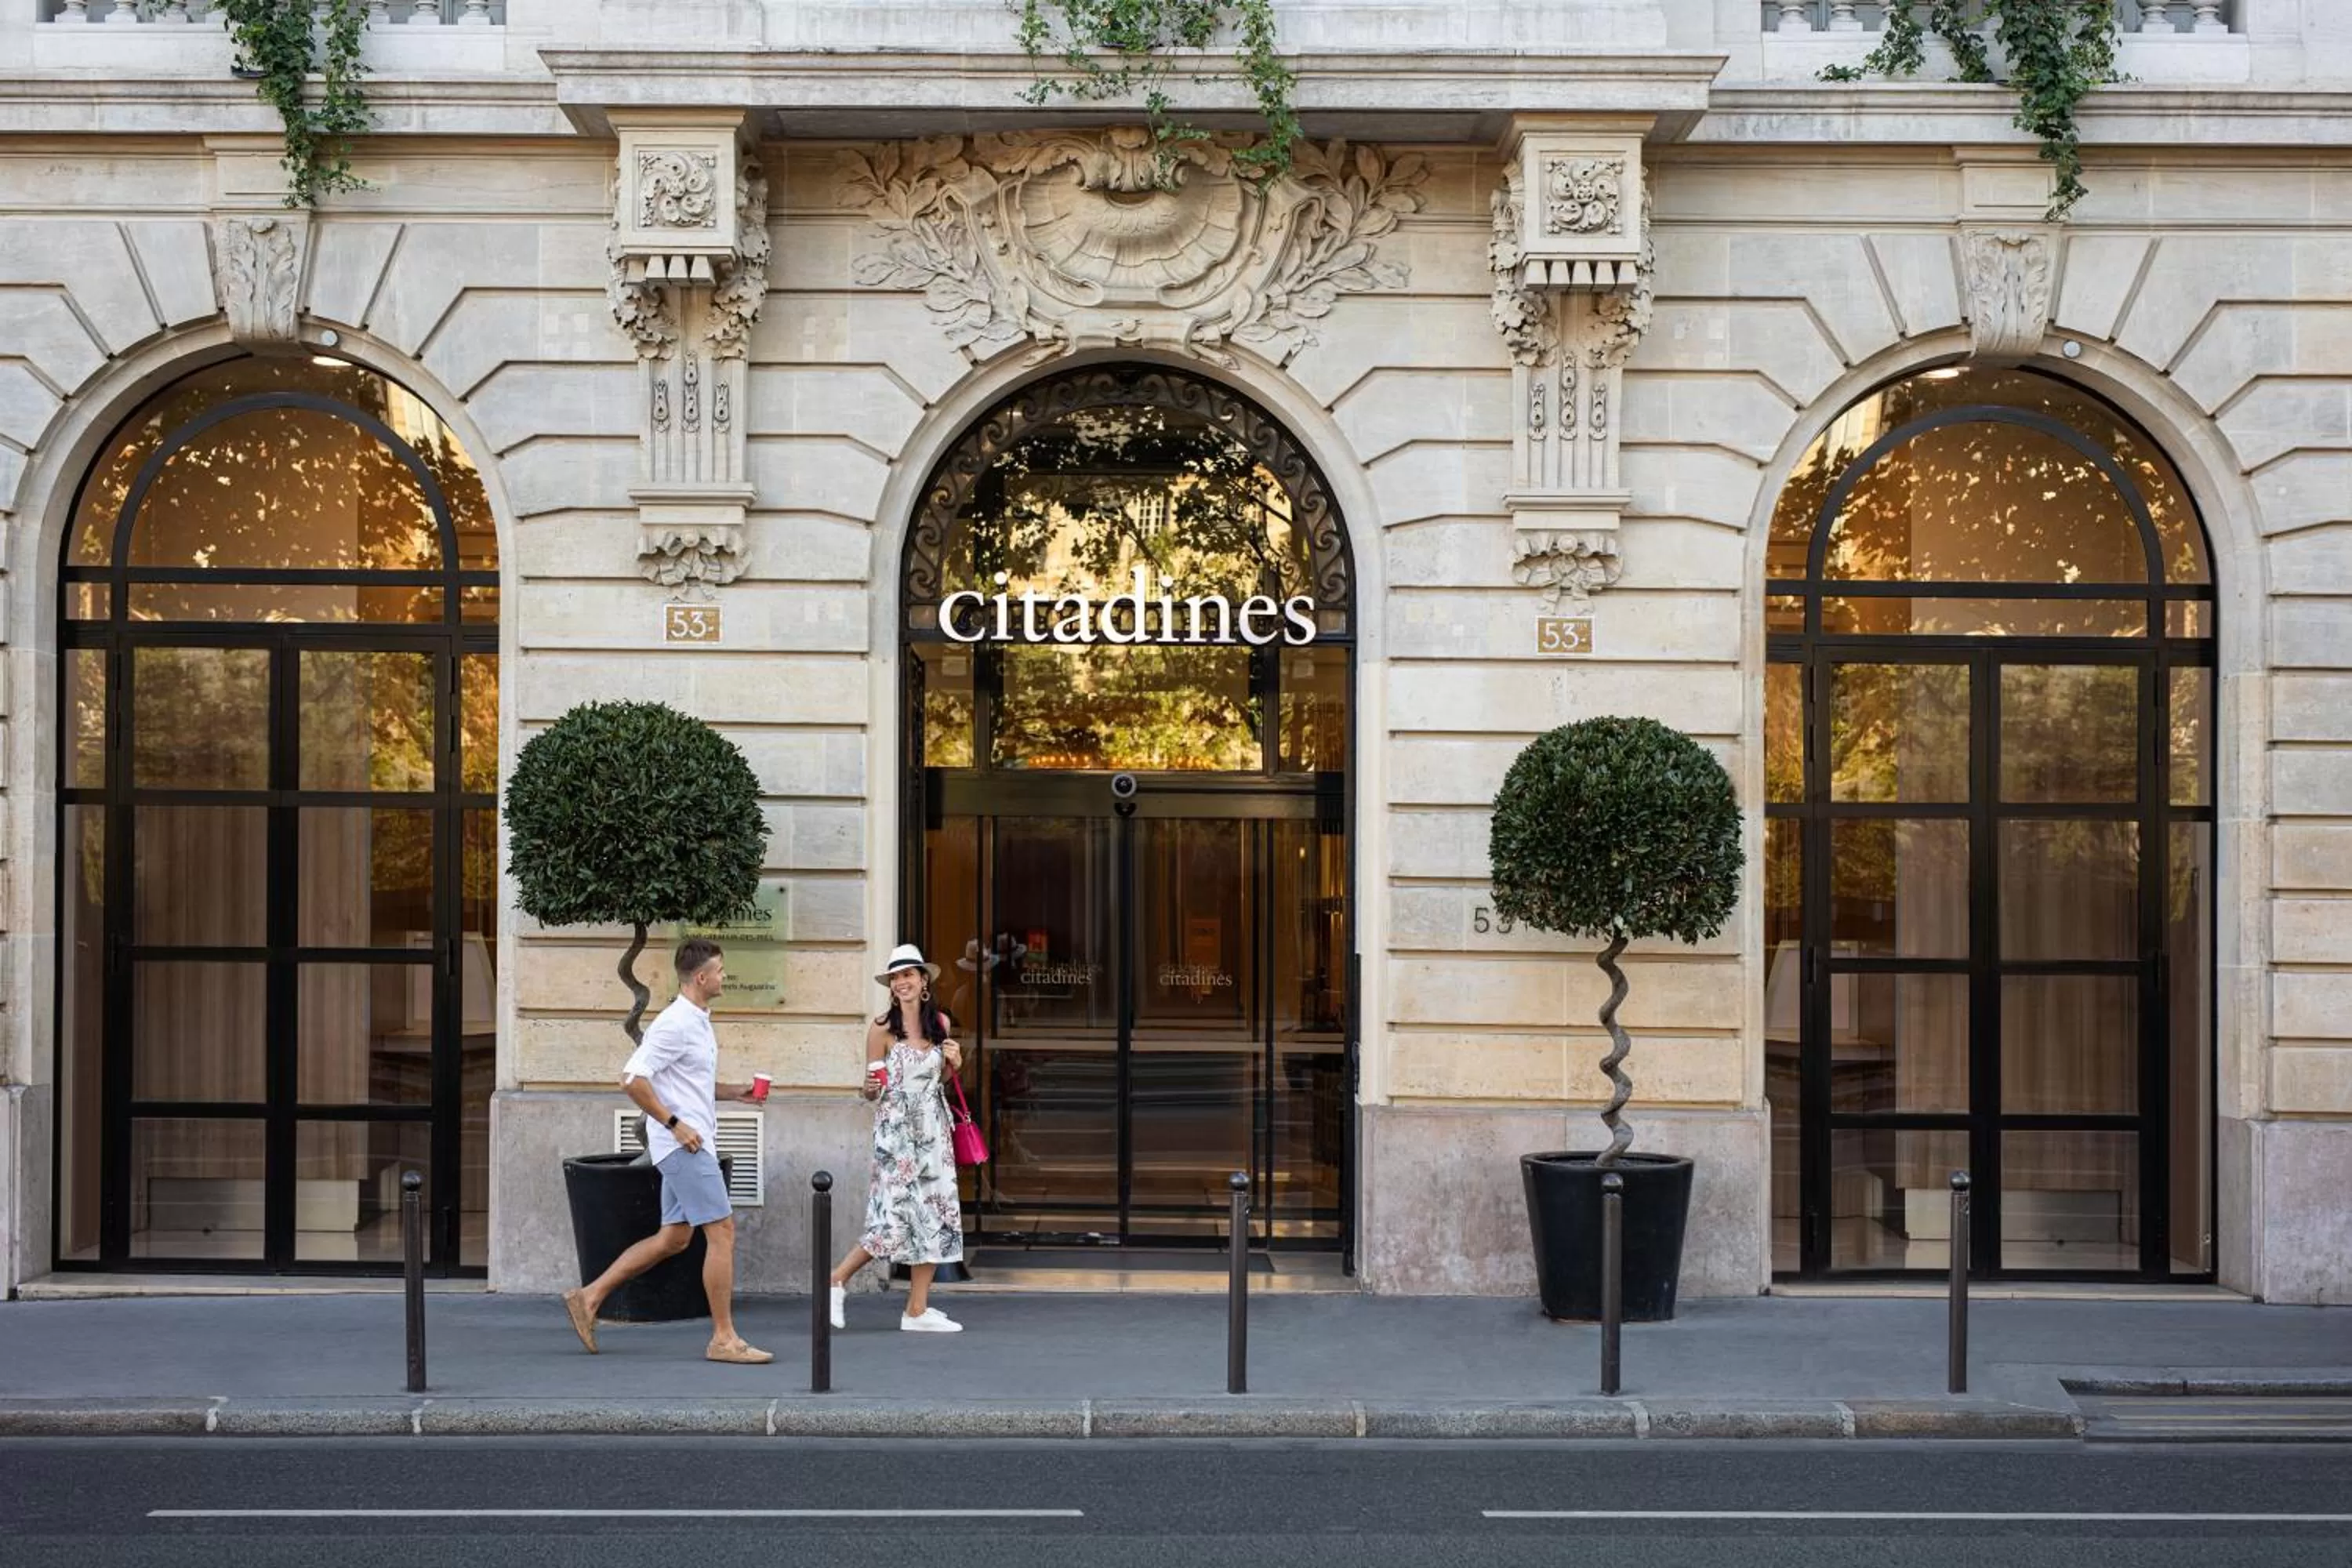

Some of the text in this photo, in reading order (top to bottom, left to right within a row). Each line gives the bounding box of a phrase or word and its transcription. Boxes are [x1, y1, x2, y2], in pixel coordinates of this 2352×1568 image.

[938, 564, 1317, 645] citadines
[1020, 967, 1092, 985] citadines
[1160, 967, 1233, 985] citadines
